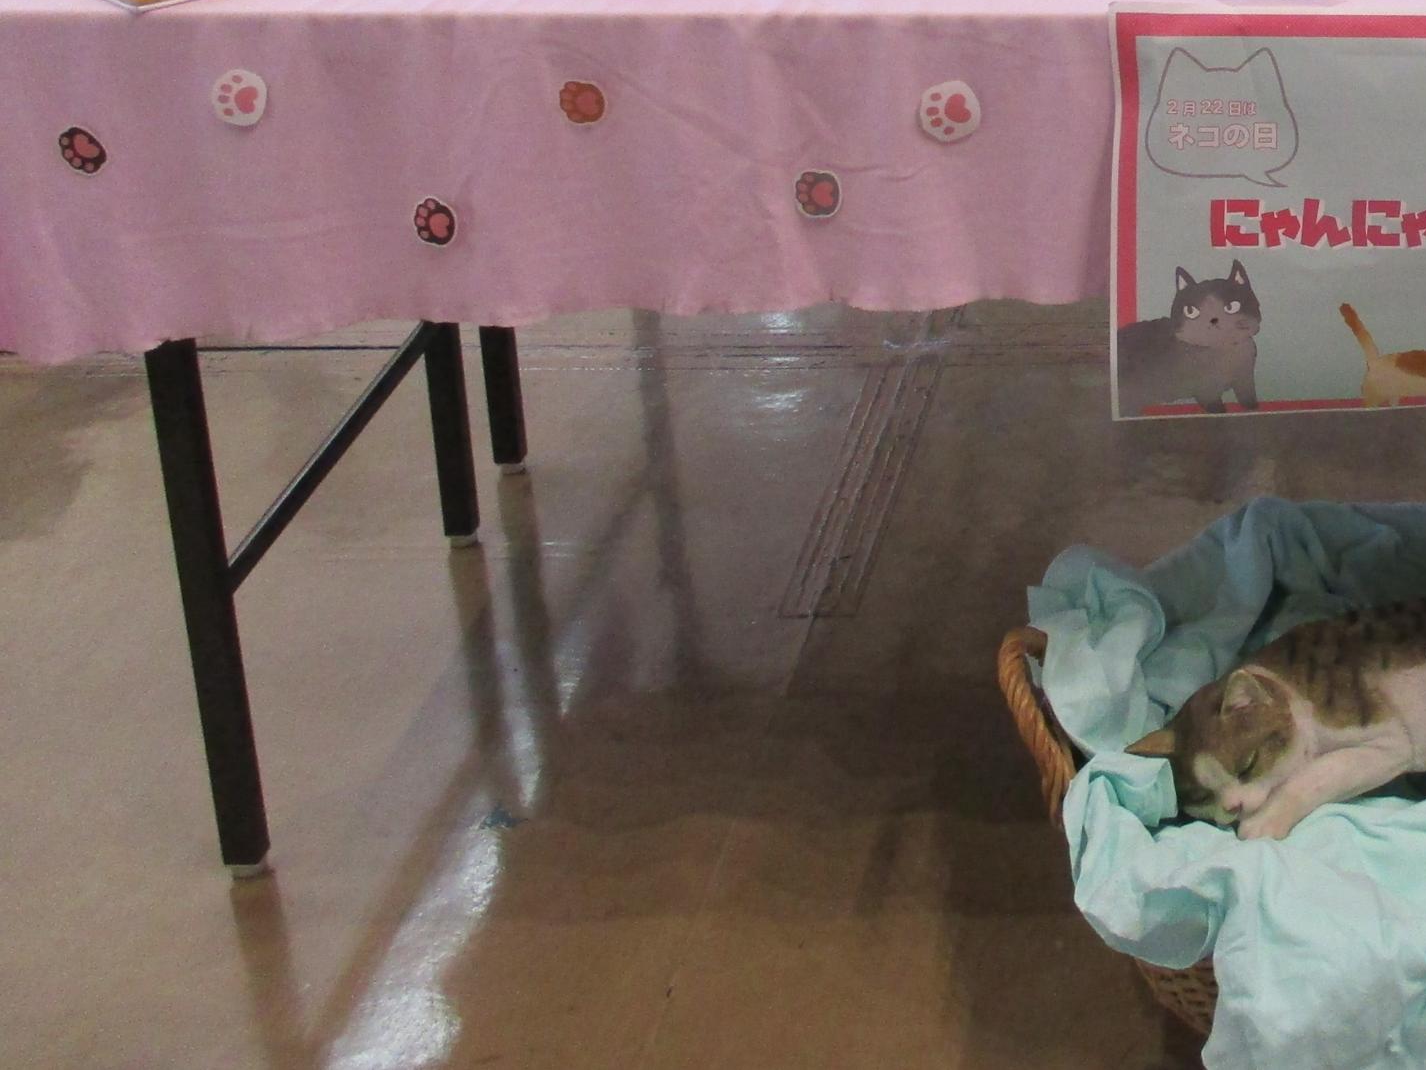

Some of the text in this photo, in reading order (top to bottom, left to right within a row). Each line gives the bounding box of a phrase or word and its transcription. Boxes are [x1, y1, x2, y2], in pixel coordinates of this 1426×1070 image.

[1166, 98, 1258, 118] 2月22日は
[1167, 122, 1279, 151] ネコの日
